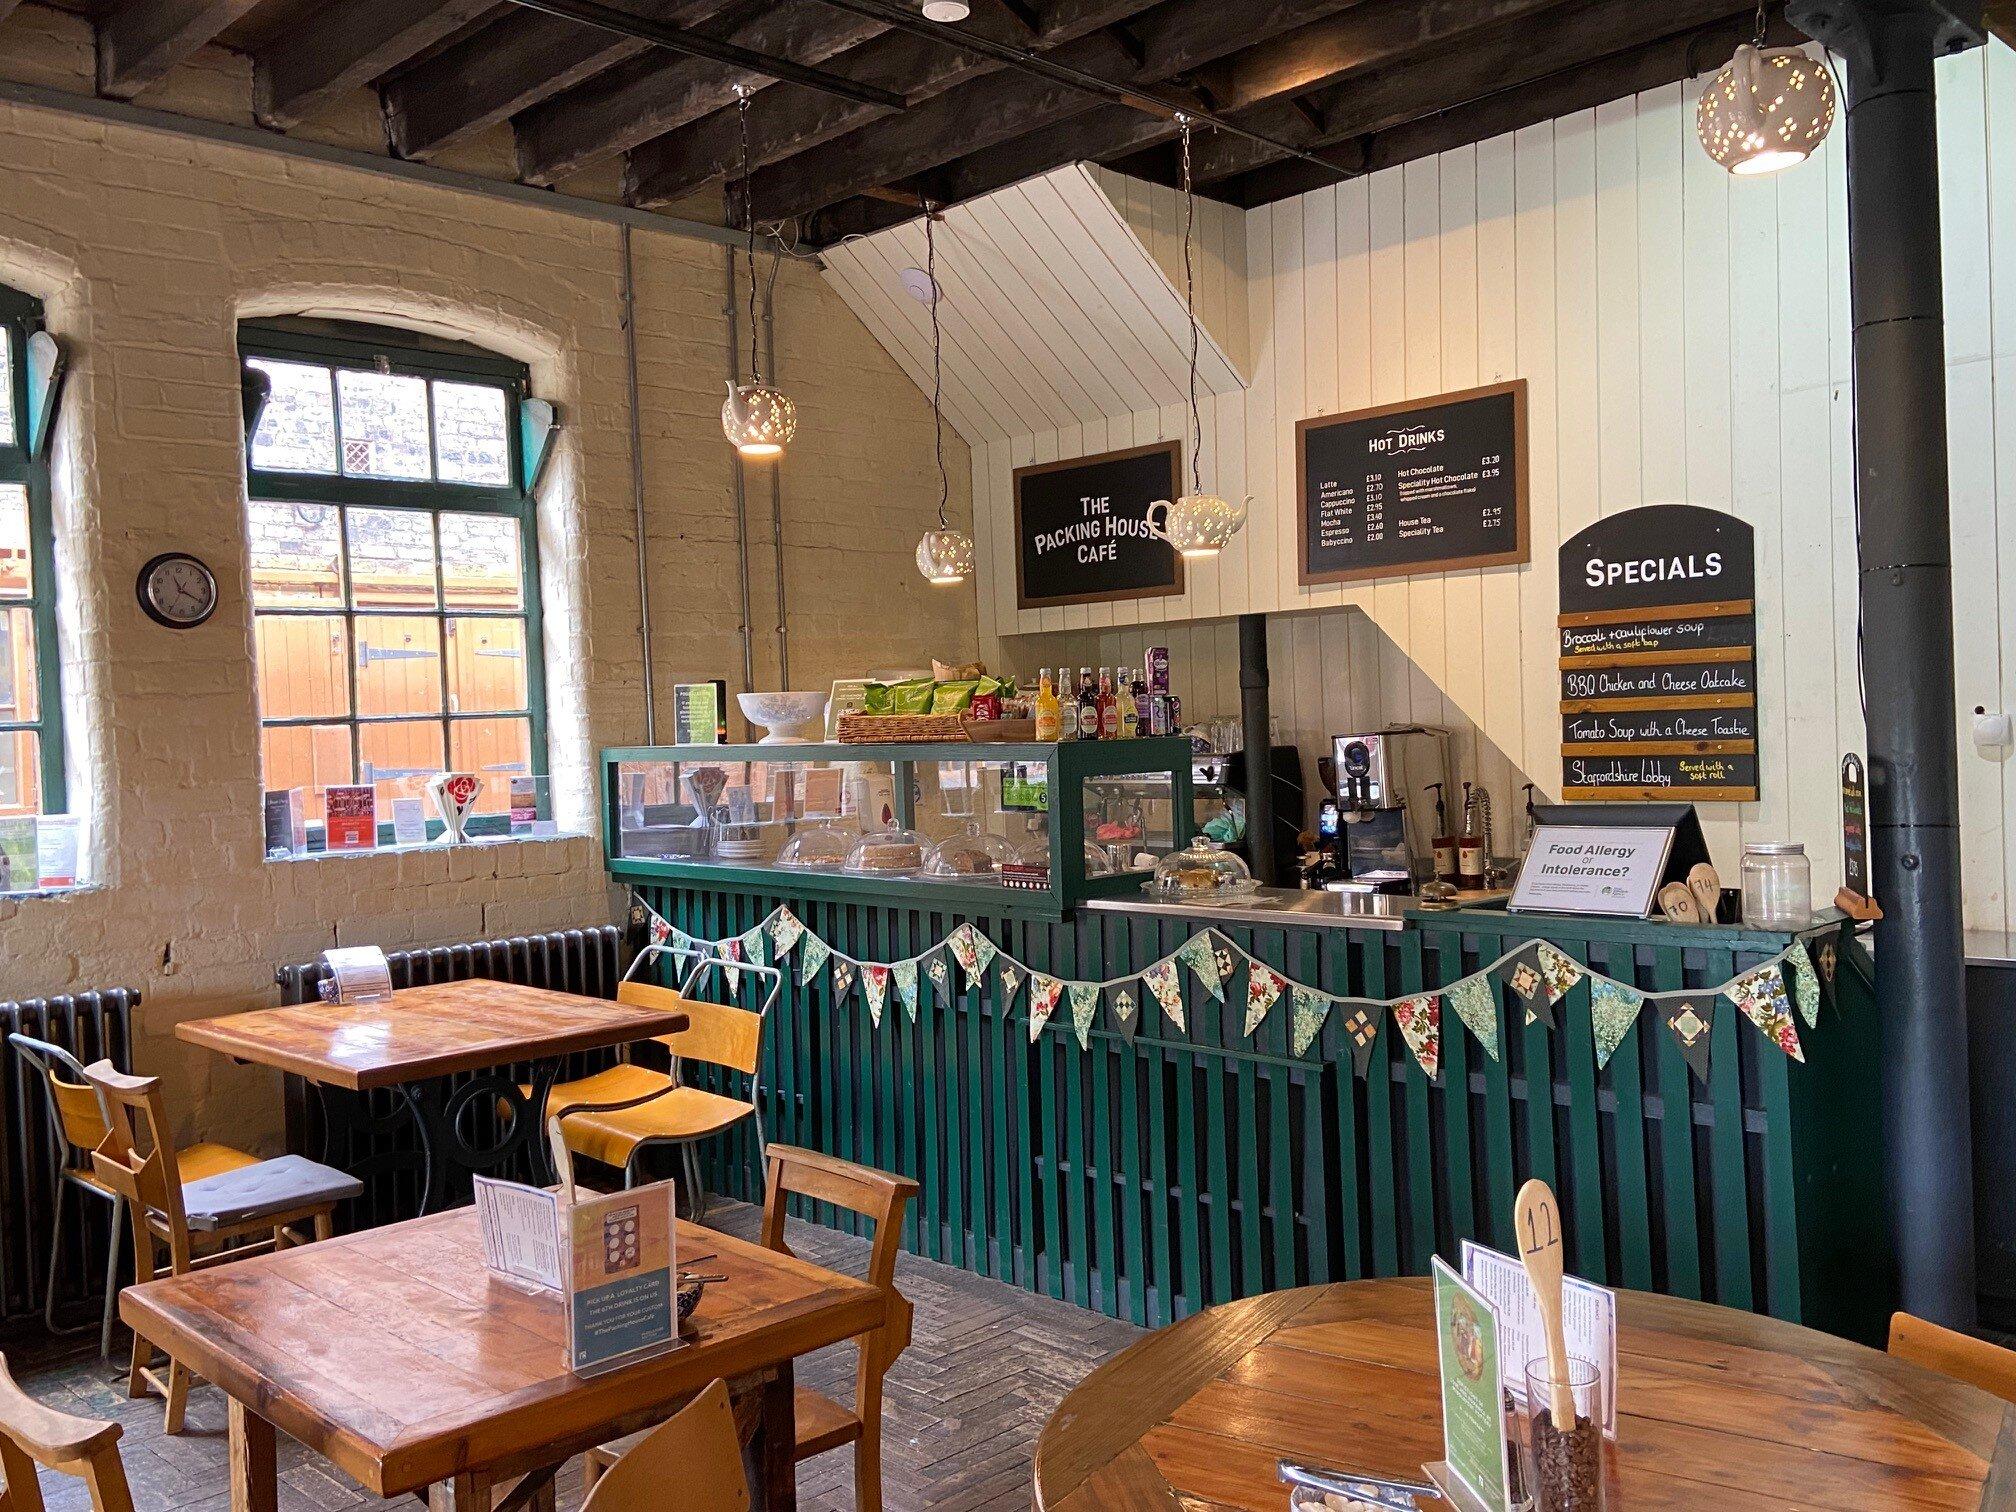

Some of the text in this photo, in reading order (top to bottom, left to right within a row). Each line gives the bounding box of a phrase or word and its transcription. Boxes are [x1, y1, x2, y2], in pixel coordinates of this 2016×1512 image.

[1368, 430, 1444, 452] HOT DRINKS
[1398, 470, 1409, 478] Hot
[1410, 464, 1444, 476] Chocolate
[1320, 481, 1337, 489] Latte
[1398, 479, 1430, 490] Speciality
[1444, 472, 1478, 483] Chocolate
[1482, 468, 1500, 478] £3.95
[1321, 483, 1383, 499] Americano £2.70
[1080, 496, 1110, 516] THE
[1321, 497, 1355, 508] Cappuccino
[1367, 503, 1382, 512] £2.95
[1399, 519, 1418, 527] House
[1034, 520, 1100, 555] PACKING
[1321, 528, 1349, 537] Espresso
[1399, 528, 1431, 538] Speciality
[1321, 538, 1353, 547] Babyccino
[1077, 540, 1117, 564] CAFÉ
[1585, 552, 1722, 587] SPECIALS
[1563, 629, 1606, 648] Broccoli
[1676, 622, 1704, 636] soup
[1574, 644, 1595, 653] Served
[1596, 642, 1614, 651] with
[1623, 640, 1640, 649] soft
[1643, 639, 1659, 648] bap
[1567, 668, 1746, 697] BBQ Chicken and Cheese Oatcake
[1569, 716, 1750, 741] Tomato Soup with a Cheese Toastie
[1572, 759, 1671, 787] Staffordshire Lobby
[1679, 761, 1705, 772] Served
[1706, 761, 1724, 771] with
[1690, 771, 1707, 780] soft
[1549, 844, 1636, 858] Food Allergy
[1541, 864, 1630, 877] Intolerance?
